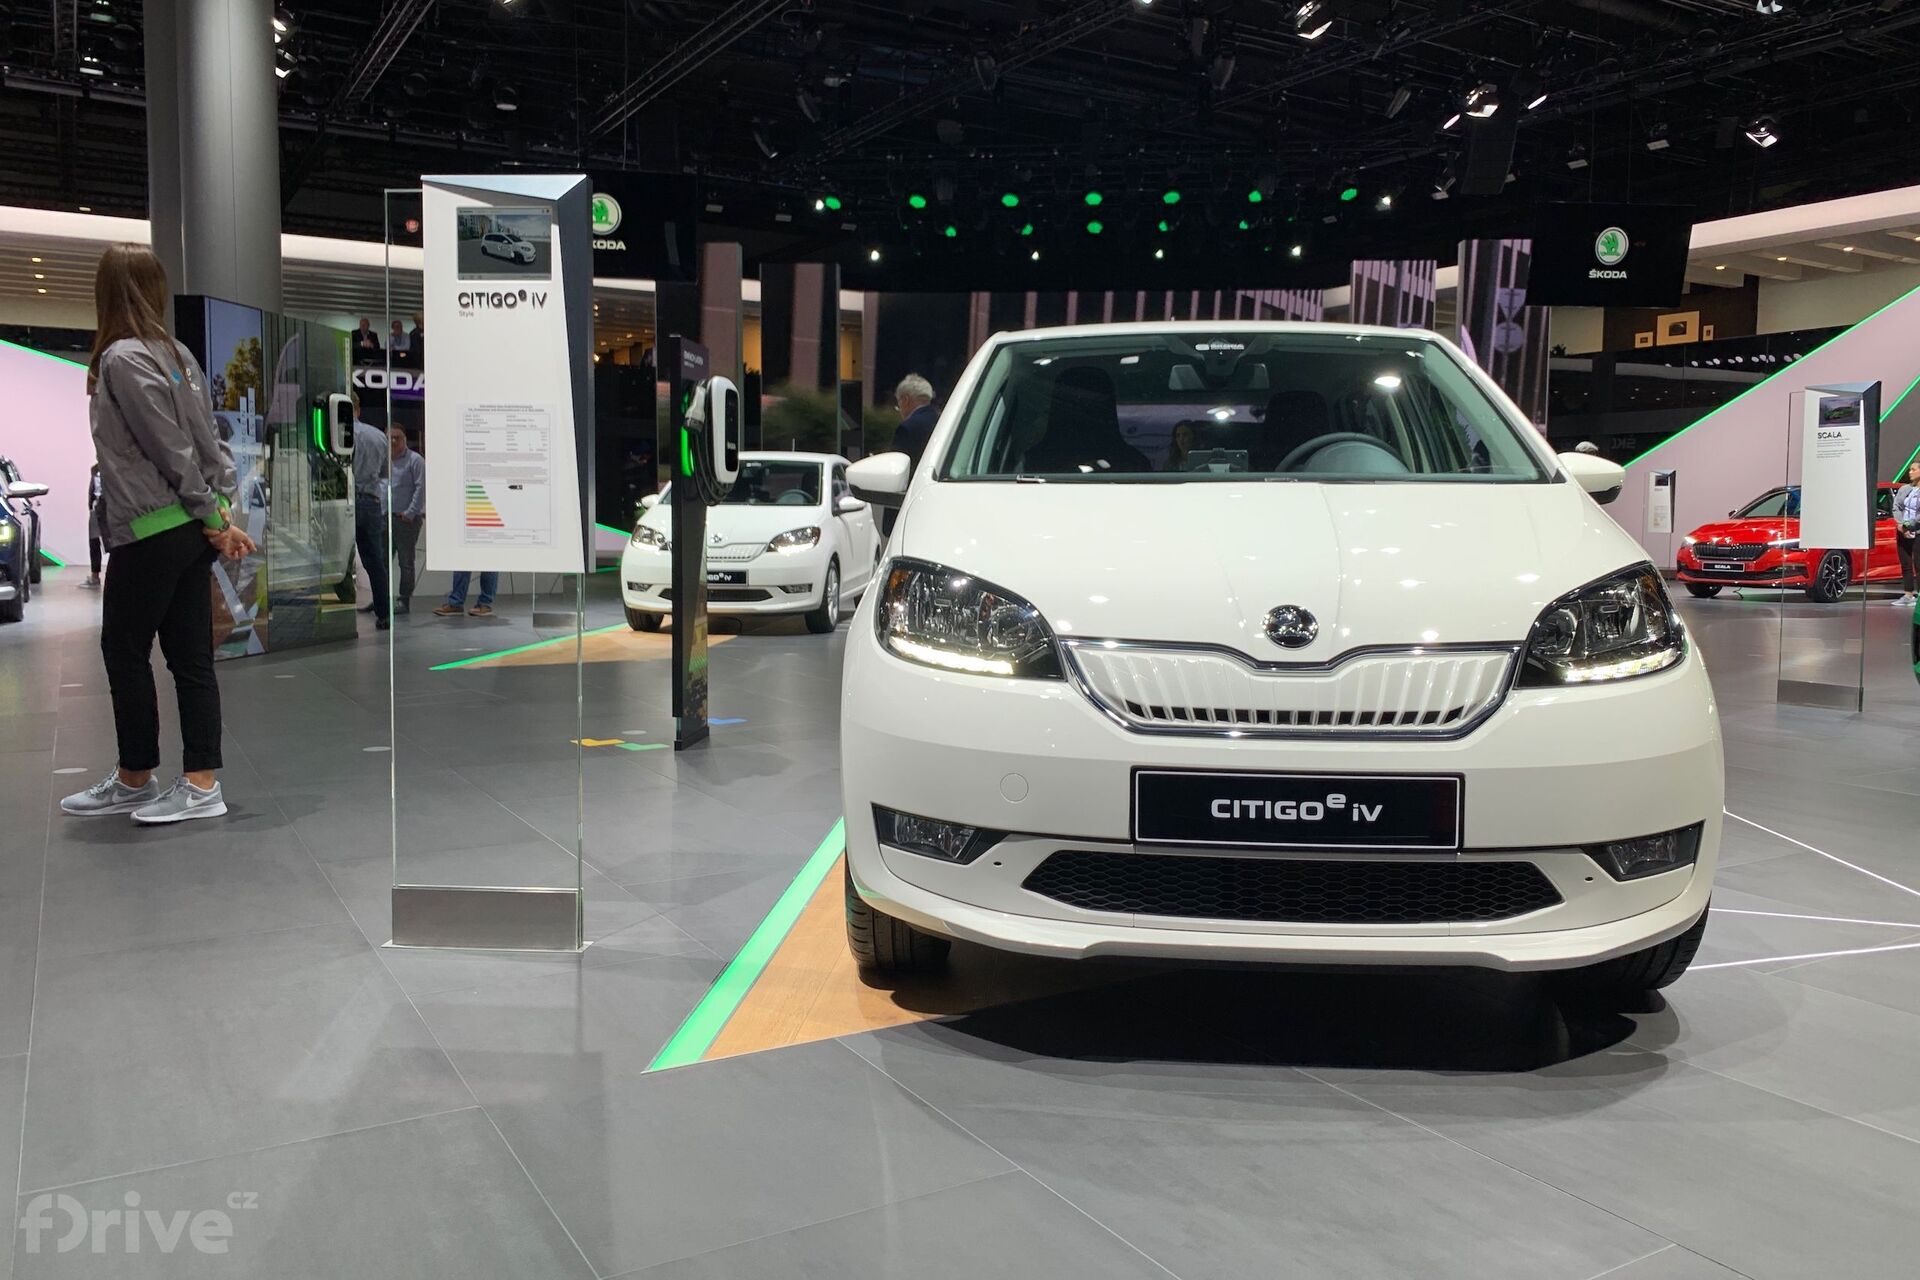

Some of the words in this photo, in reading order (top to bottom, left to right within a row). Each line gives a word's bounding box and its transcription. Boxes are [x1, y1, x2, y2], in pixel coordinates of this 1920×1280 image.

[593, 240, 626, 251] KODA
[1588, 268, 1627, 279] ŠKODA
[352, 369, 426, 391] KODA
[1817, 431, 1842, 440] SCALA
[1352, 803, 1383, 822] iV
